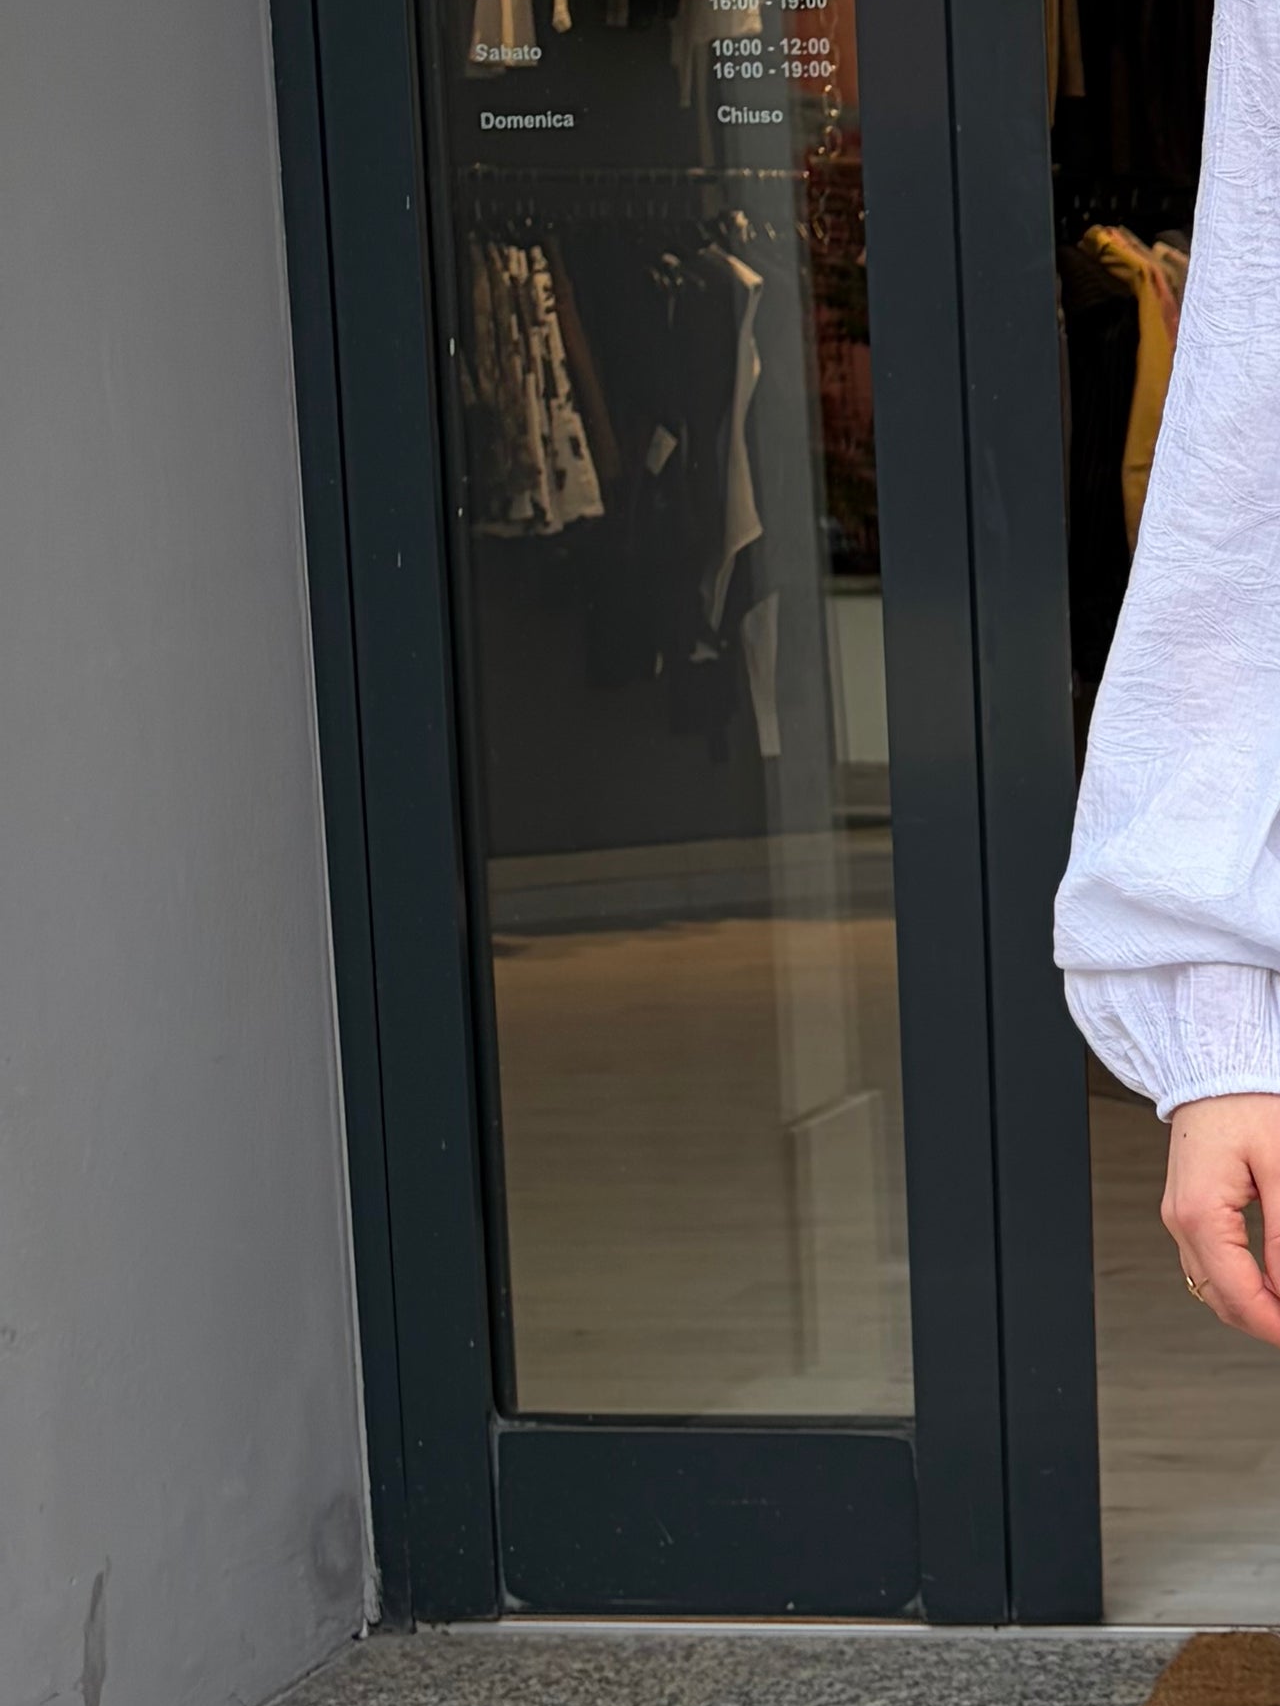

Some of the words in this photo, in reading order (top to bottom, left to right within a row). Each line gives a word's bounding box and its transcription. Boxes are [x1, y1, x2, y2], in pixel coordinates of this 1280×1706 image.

[475, 43, 542, 63] Sabato
[712, 38, 762, 57] 10:00
[779, 37, 830, 55] 12:00
[781, 60, 831, 78] 19:00
[480, 110, 574, 130] Domenica
[717, 105, 783, 125] Chiuso
